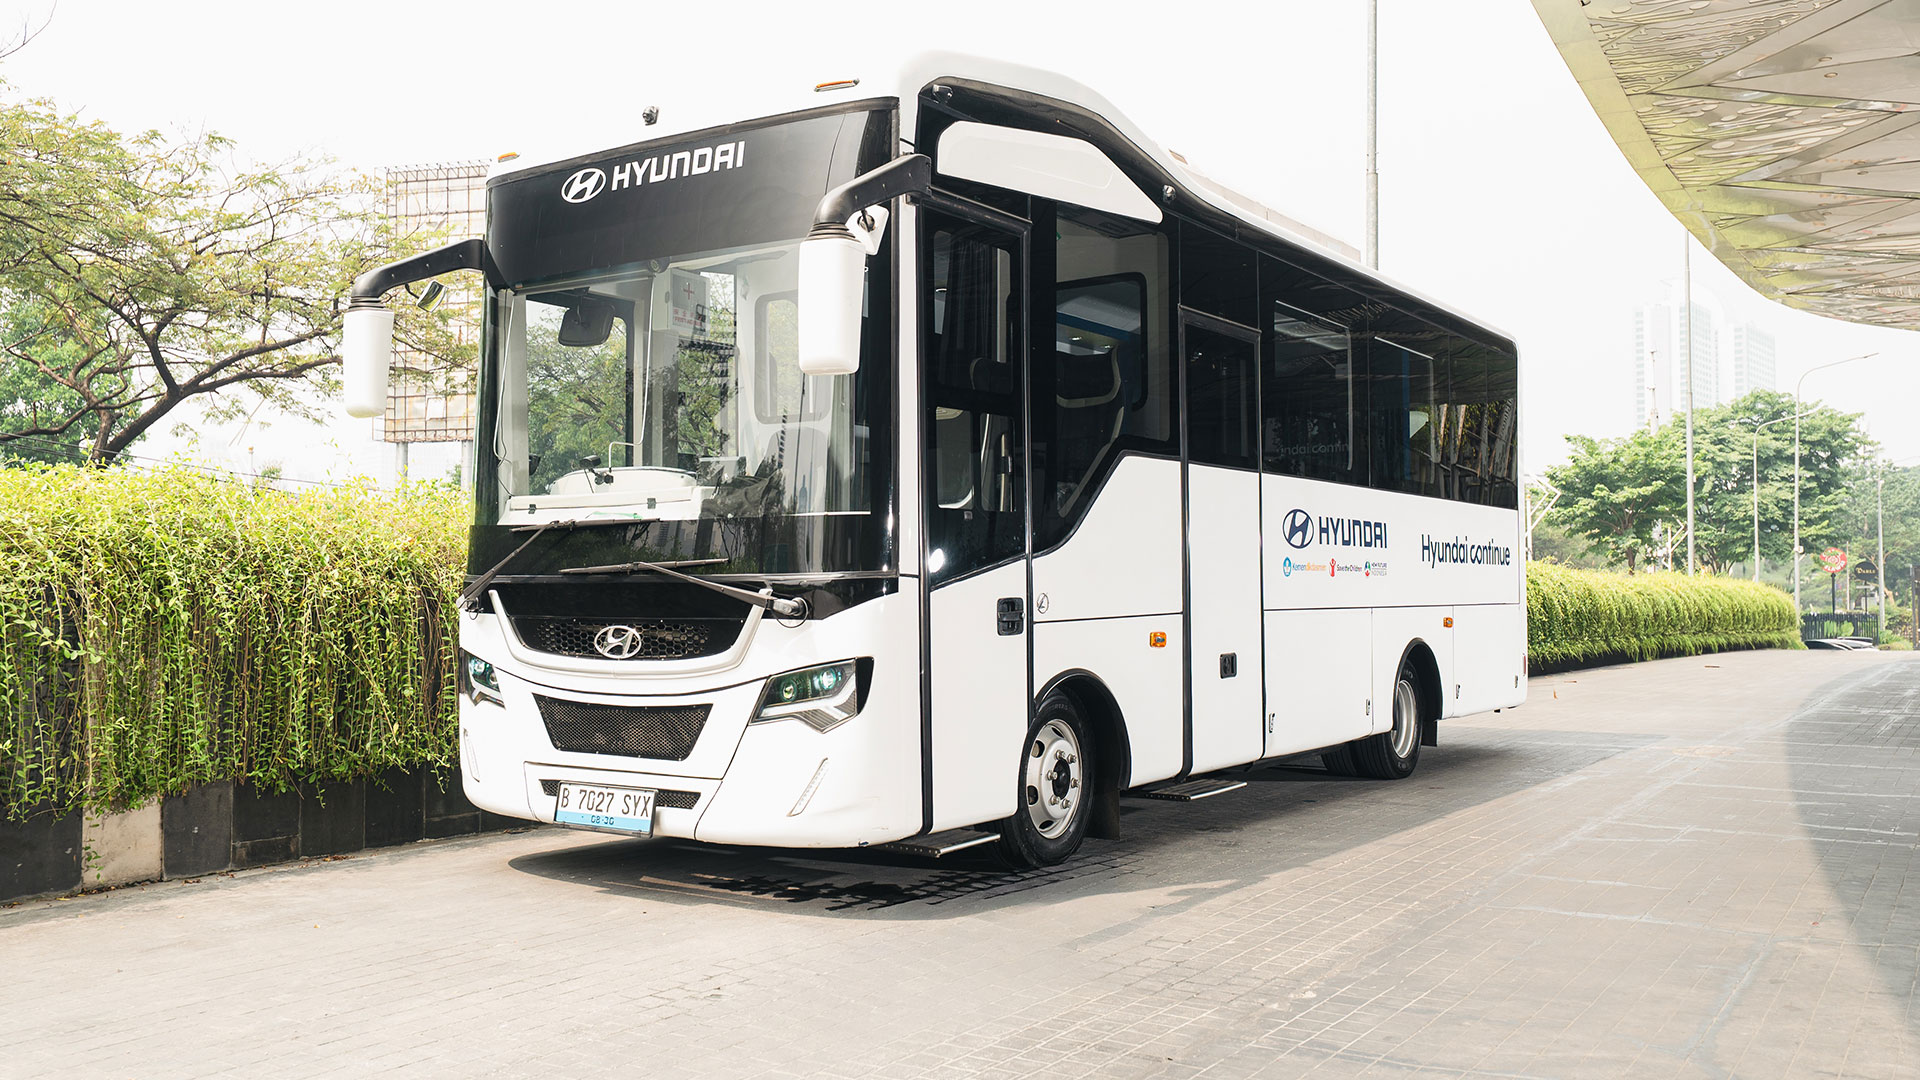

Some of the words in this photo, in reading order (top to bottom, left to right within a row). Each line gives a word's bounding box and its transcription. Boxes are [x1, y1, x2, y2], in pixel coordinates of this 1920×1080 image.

[611, 141, 746, 191] HYUNDAI
[1318, 516, 1388, 549] HYUNDAI
[1421, 533, 1469, 569] Hyundai
[1470, 537, 1511, 566] continue
[560, 787, 570, 808] B
[578, 789, 615, 813] 7027
[621, 794, 651, 817] SYX
